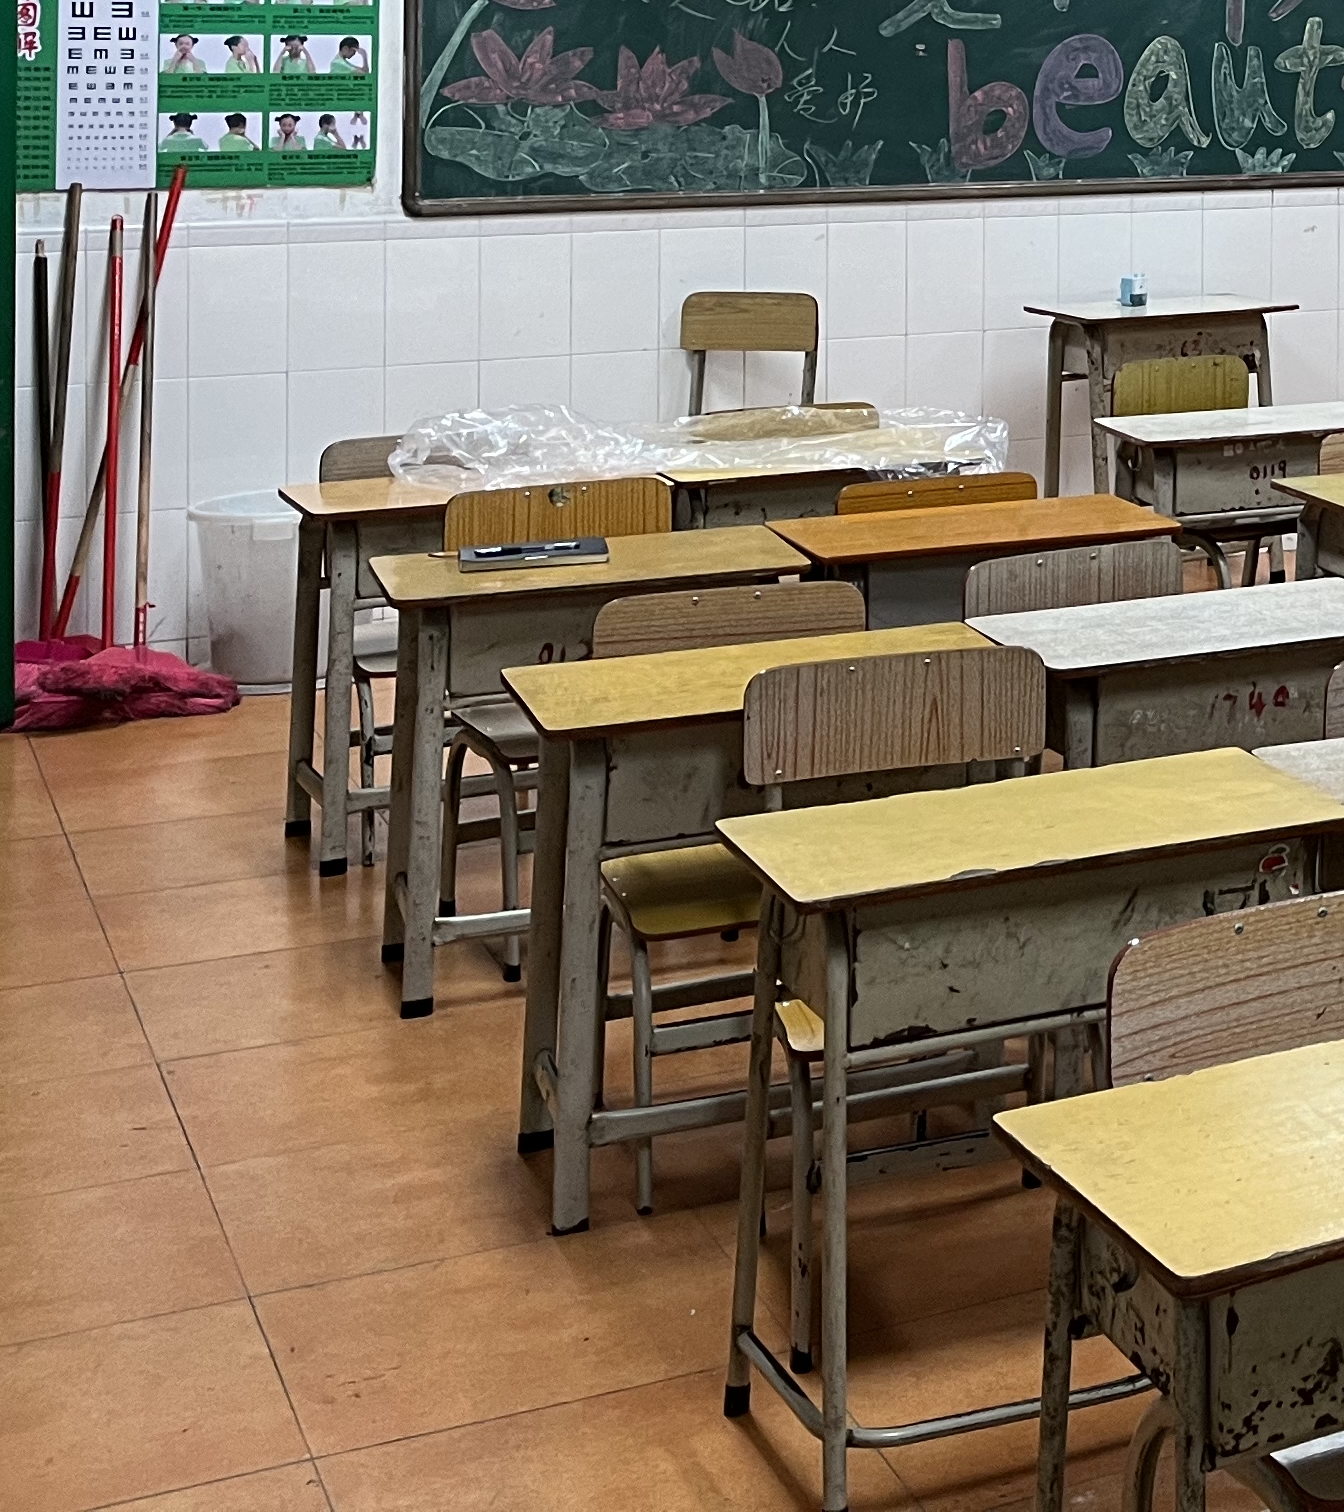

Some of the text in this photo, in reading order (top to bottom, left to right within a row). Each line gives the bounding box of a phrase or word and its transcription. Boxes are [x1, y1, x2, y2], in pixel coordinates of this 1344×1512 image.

[775, 20, 857, 62] 人人
[783, 65, 877, 130] 爱护
[1249, 459, 1287, 481] 0119
